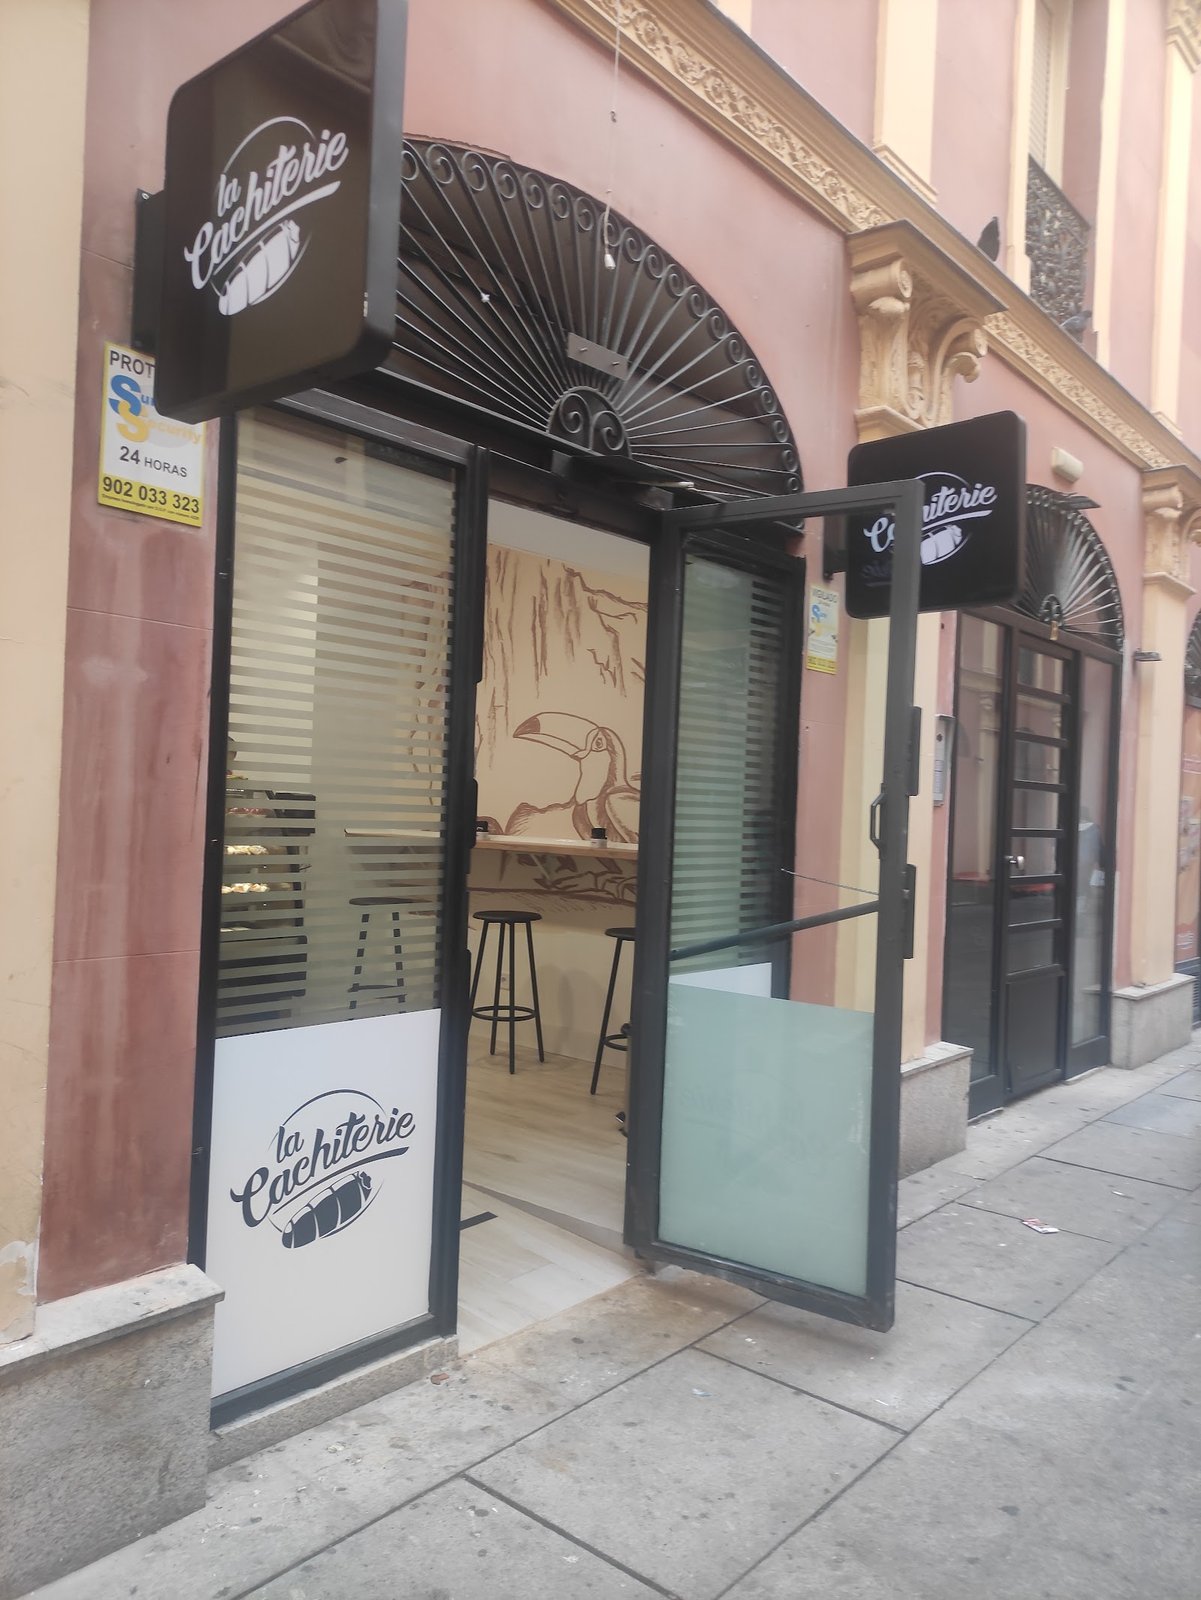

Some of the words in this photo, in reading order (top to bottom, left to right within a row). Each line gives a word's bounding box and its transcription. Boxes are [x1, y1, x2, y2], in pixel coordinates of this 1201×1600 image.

[183, 128, 350, 290] Cachiterie
[217, 173, 241, 217] la
[109, 350, 156, 378] PROT
[119, 445, 141, 465] 24
[144, 457, 188, 478] HORAS
[102, 476, 133, 498] 902
[138, 484, 168, 506] 033
[172, 493, 200, 514] 323
[275, 1125, 304, 1164] la
[229, 1107, 416, 1228] Cachiterie
